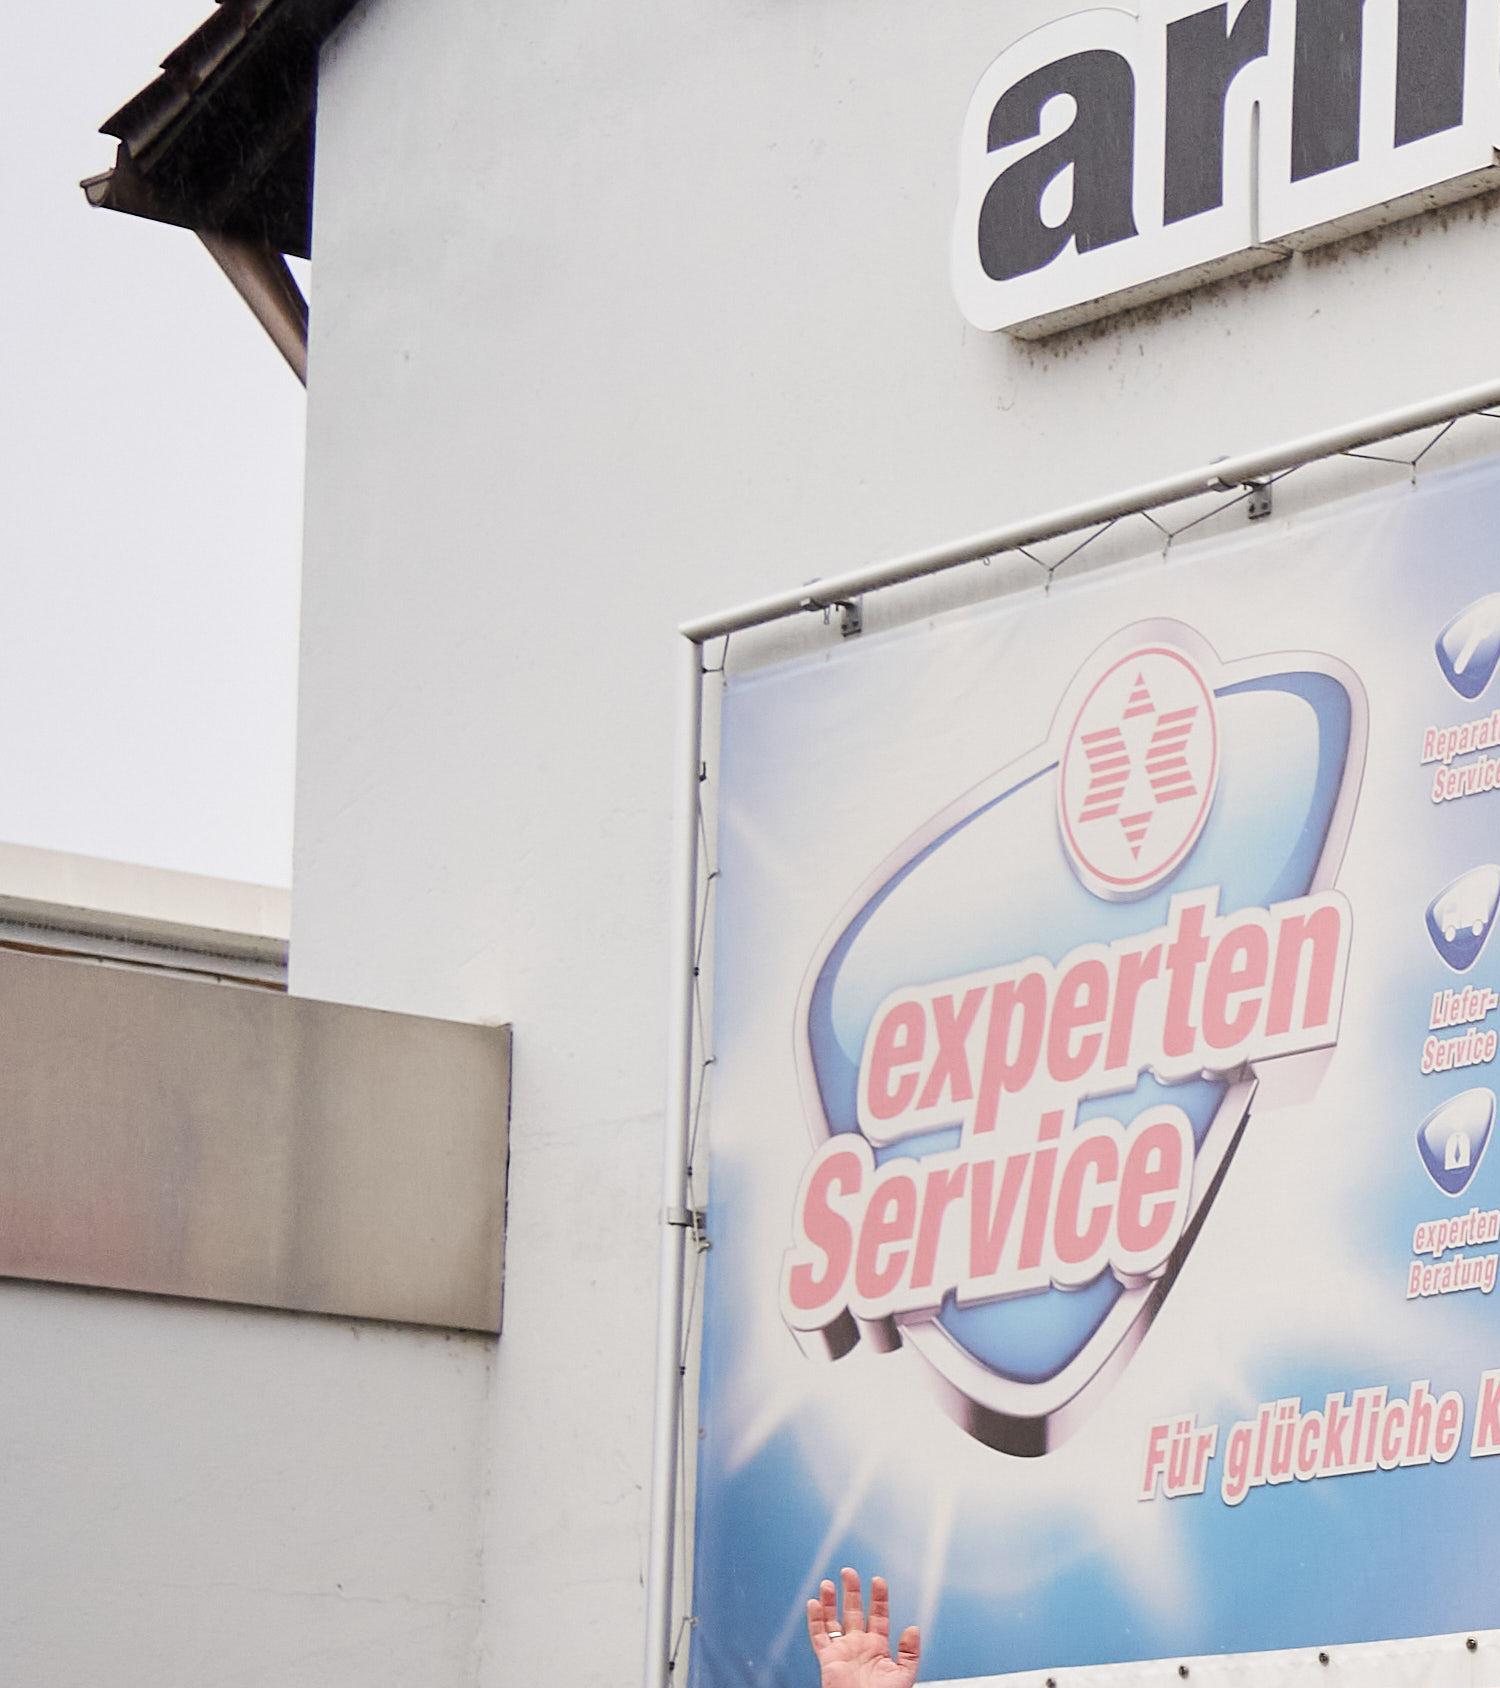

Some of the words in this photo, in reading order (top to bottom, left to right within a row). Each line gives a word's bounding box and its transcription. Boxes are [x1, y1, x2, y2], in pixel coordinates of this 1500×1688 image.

[866, 902, 1341, 1136] experten
[1430, 986, 1499, 1028] Liefer-
[1422, 1029, 1497, 1073] Service
[788, 1108, 1184, 1311] Service
[1413, 1207, 1500, 1257] experten
[1408, 1256, 1497, 1298] Beratung
[1143, 1418, 1212, 1495] Für
[1225, 1390, 1457, 1498] glückliche
